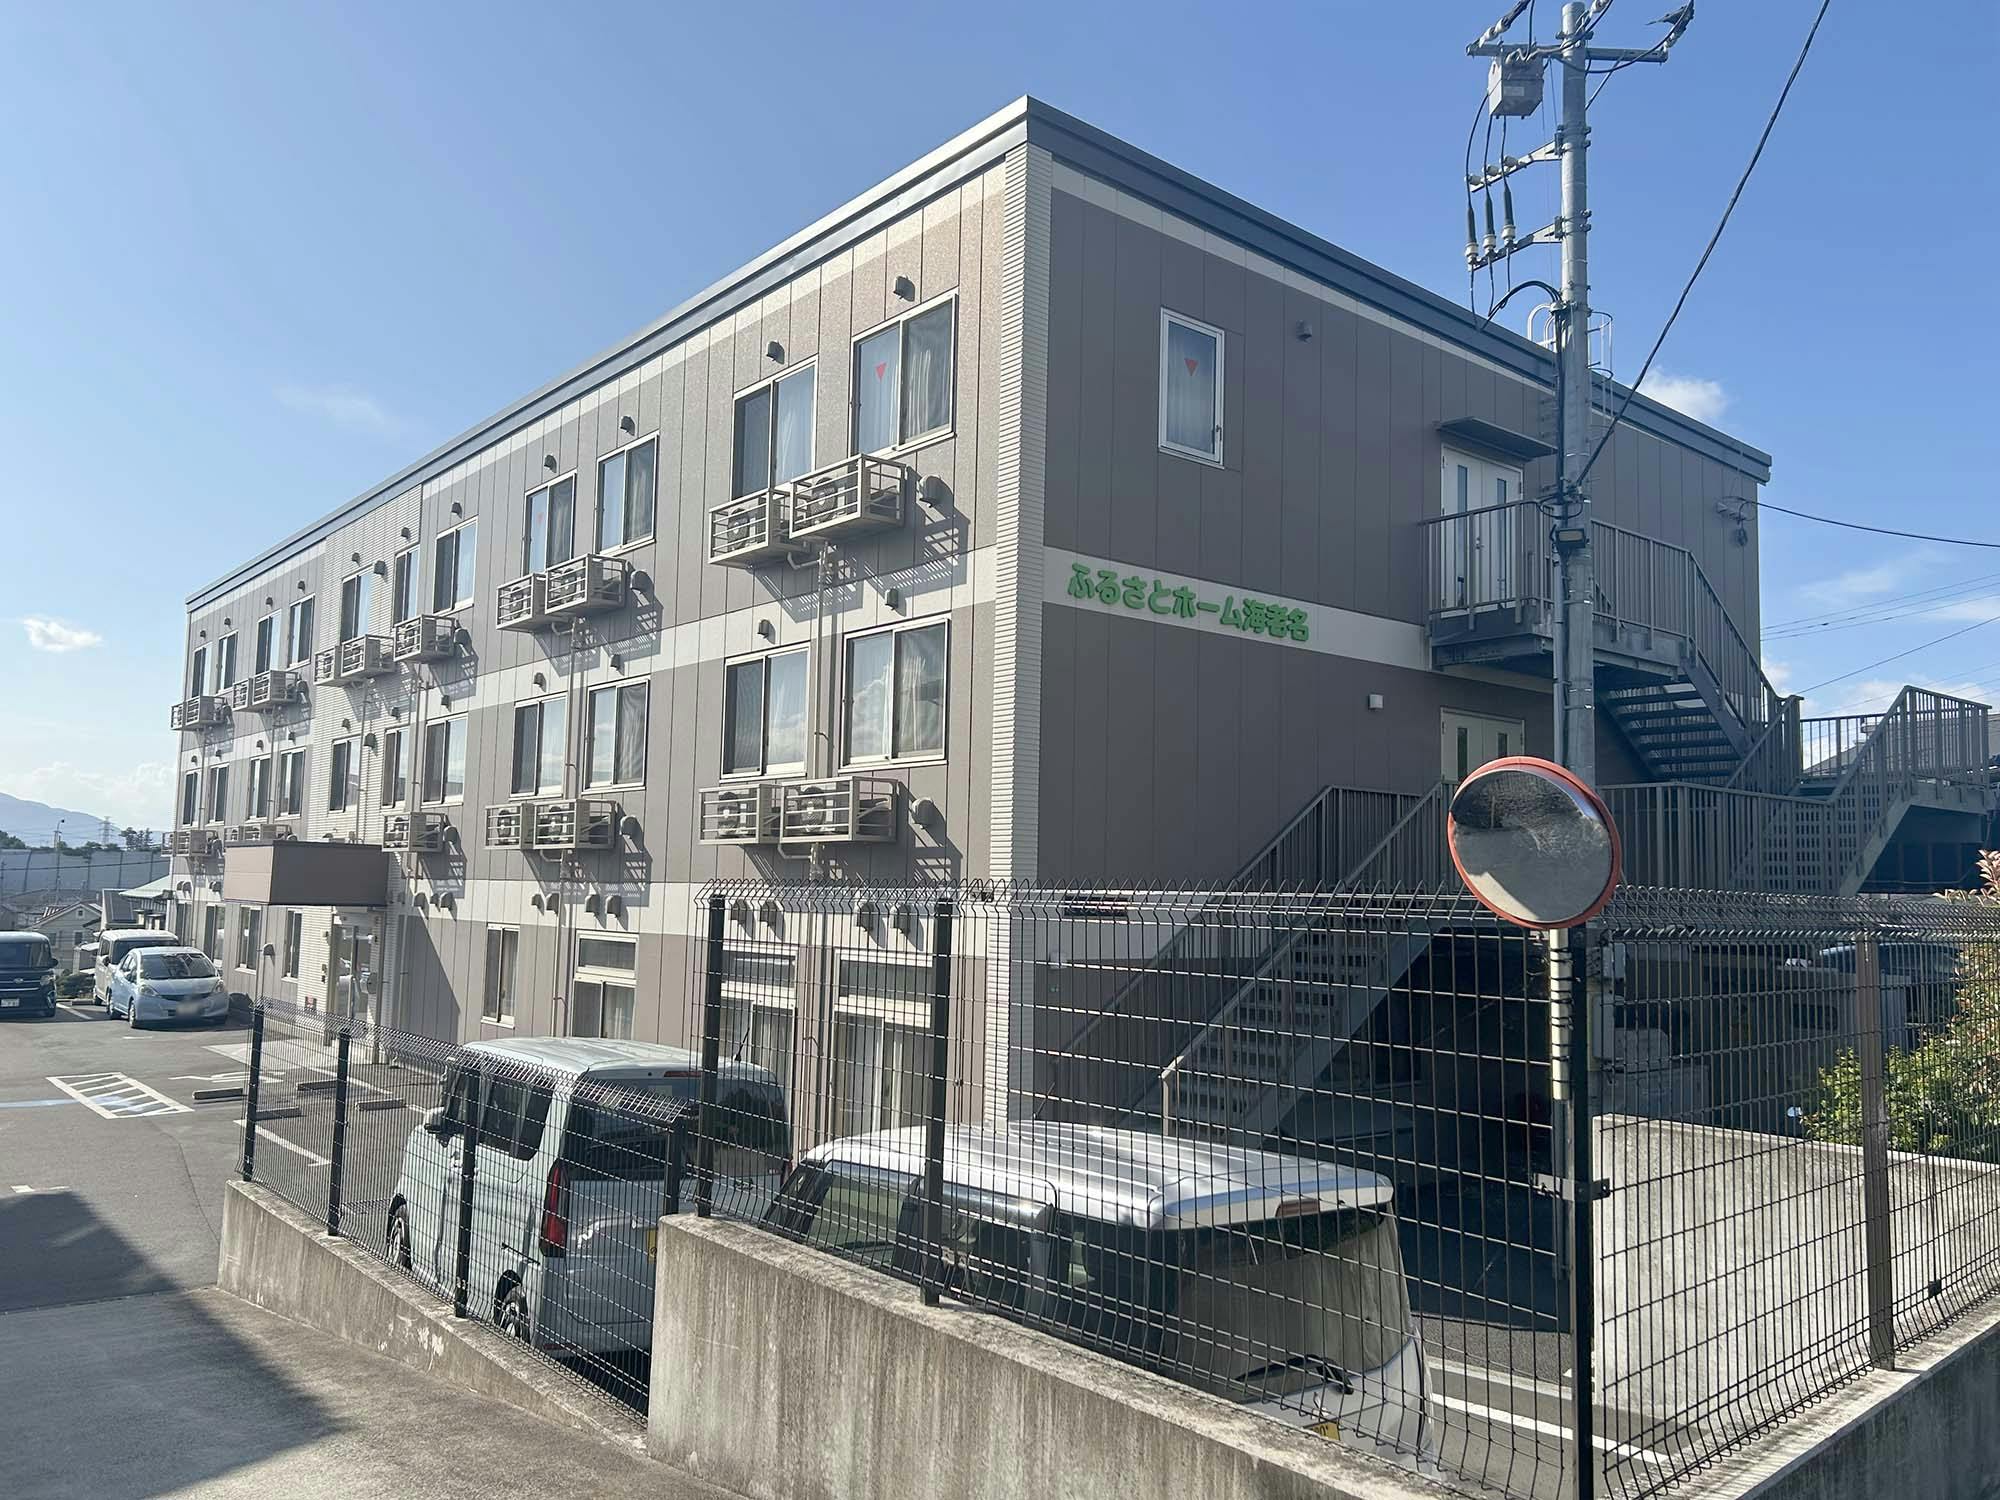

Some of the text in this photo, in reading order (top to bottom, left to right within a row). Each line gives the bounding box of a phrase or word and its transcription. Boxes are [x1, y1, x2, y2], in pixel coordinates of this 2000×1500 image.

[1068, 564, 1309, 641] ふるさとホーム海老名
